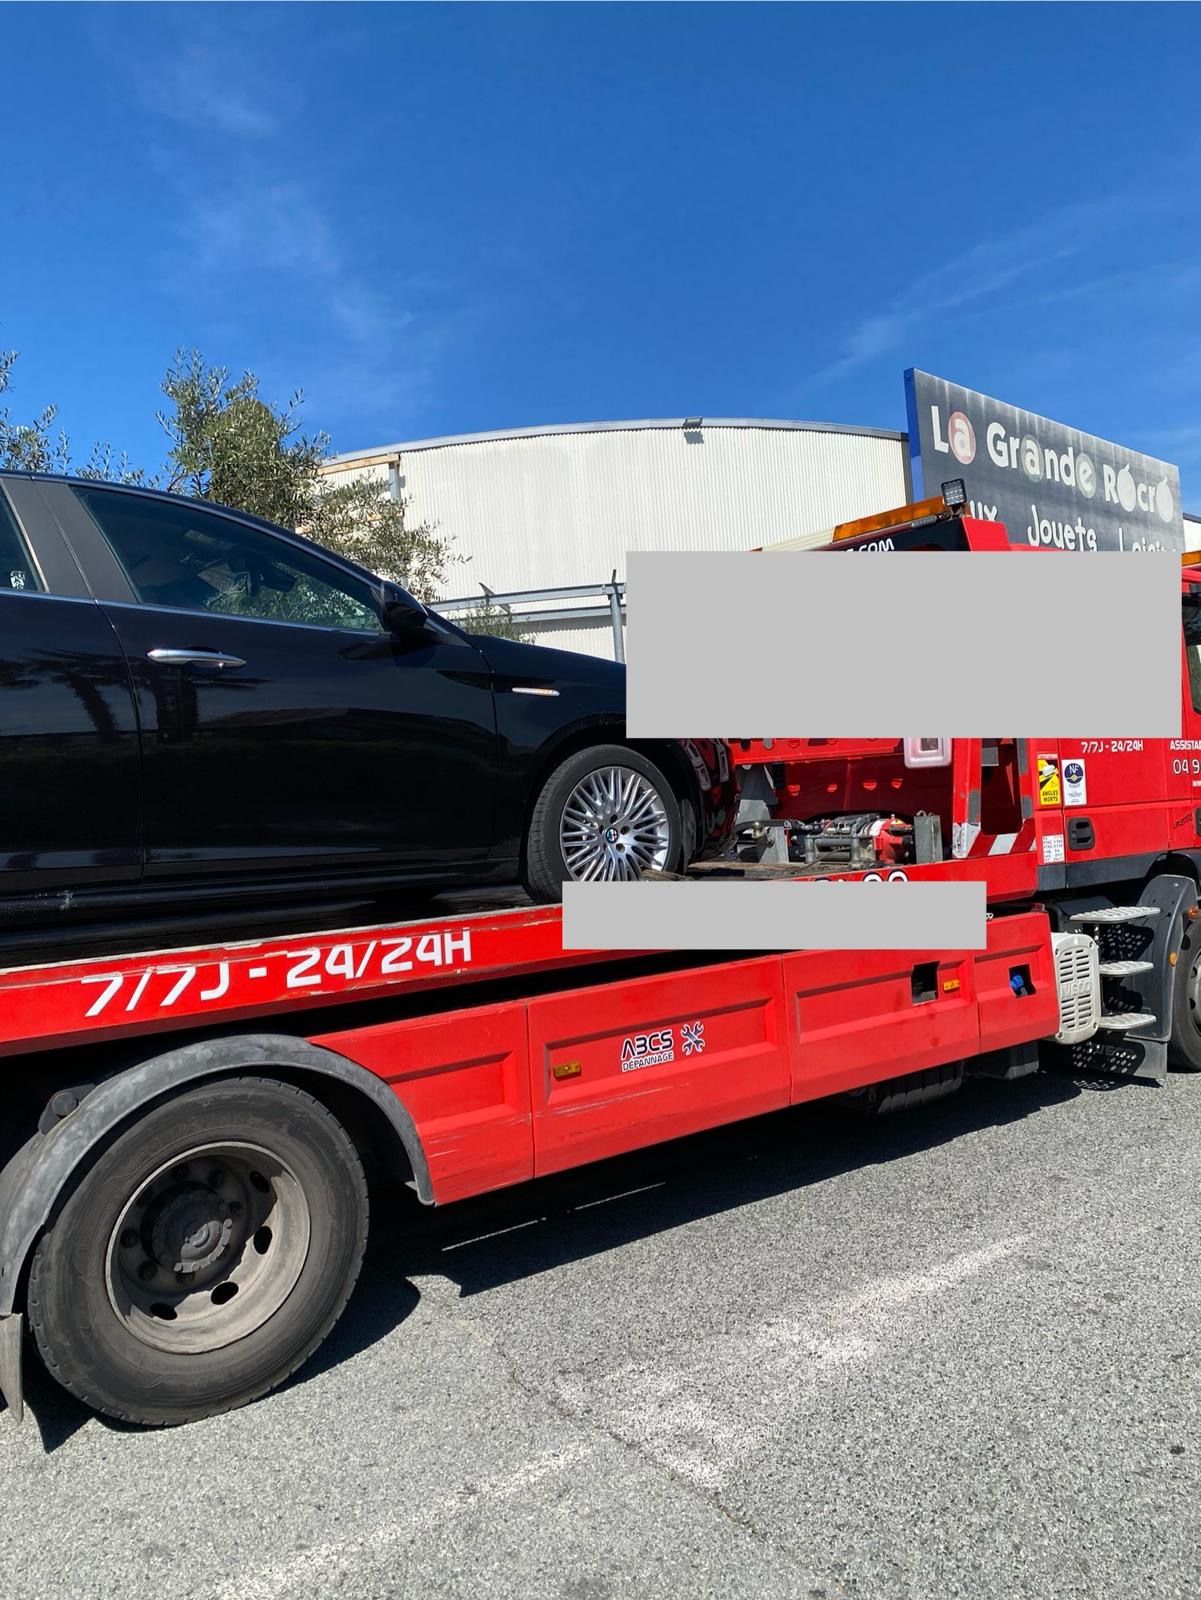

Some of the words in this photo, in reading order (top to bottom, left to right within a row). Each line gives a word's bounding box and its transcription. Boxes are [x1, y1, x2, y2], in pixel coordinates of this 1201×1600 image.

[931, 405, 975, 463] La
[987, 422, 1096, 497] Grande
[1027, 504, 1097, 551] Jouets
[1081, 741, 1103, 753] 7/7J
[1173, 759, 1189, 774] 04
[1192, 759, 1201, 774] 9
[81, 961, 229, 1017] 7/7J
[287, 928, 472, 988] 24/24H
[621, 1030, 673, 1059] ABCS
